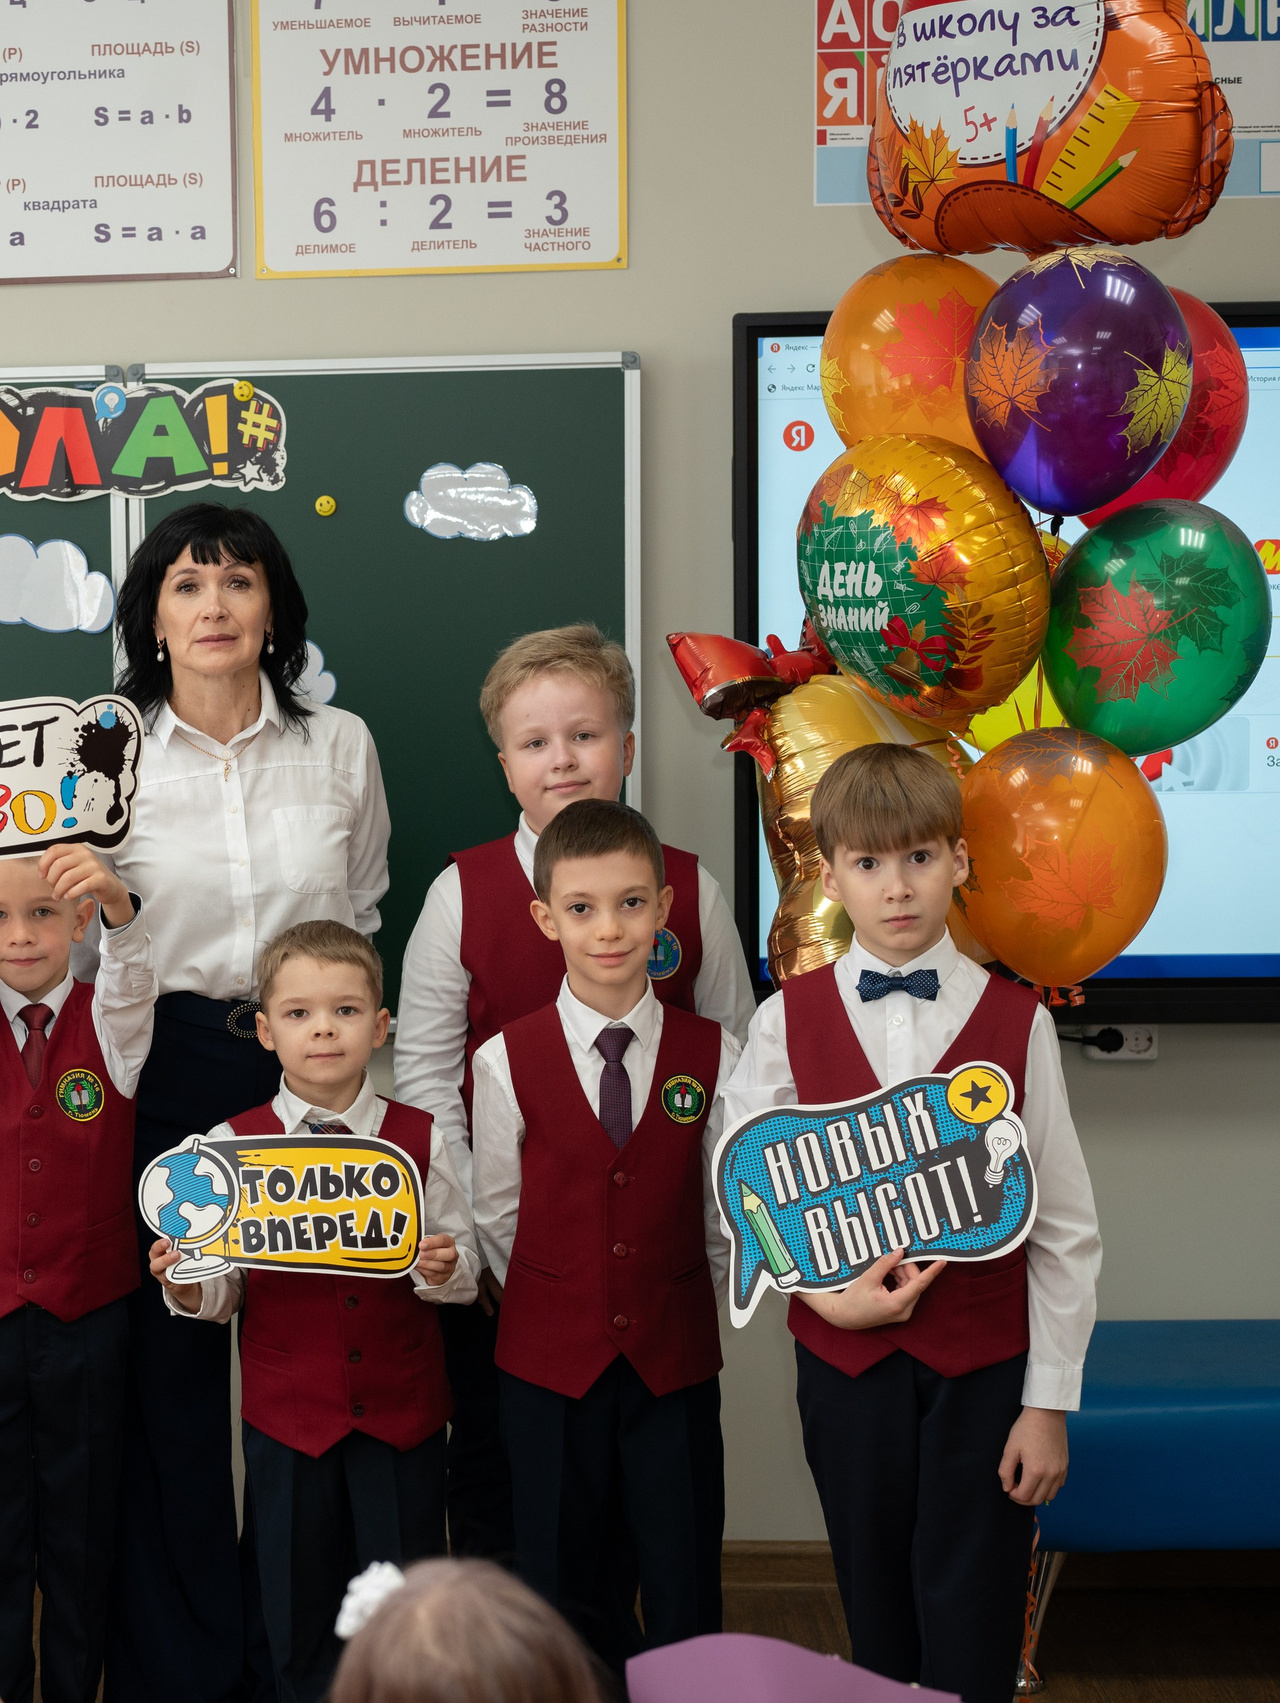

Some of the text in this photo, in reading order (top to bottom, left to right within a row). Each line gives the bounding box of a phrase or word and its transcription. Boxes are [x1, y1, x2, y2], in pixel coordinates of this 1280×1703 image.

[393, 13, 483, 27] ВЫЧИТАЕМОЕ
[521, 7, 589, 21] ЗНАЧЕНИЕ
[271, 17, 372, 32] УМЕНЬШАЕМОЕ
[521, 21, 589, 34] РАЗНОСТИ
[913, 8, 1020, 46] школу
[1033, 4, 1080, 28] за
[90, 39, 201, 58] ПЛОЩАДЬ (S)
[318, 40, 559, 77] УМНОЖЕНИЕ
[892, 47, 1080, 97] пятёрками
[309, 77, 569, 123] 4 2 8
[402, 126, 483, 139] МНОЖИТЕЛЬ
[522, 119, 590, 133] ЗНАЧЕНИЕ
[963, 105, 998, 143] 5+
[283, 130, 364, 143] МНОЖИТЕЛЬ
[505, 133, 608, 147] ПРОИЗВЕДЕНИЯ
[93, 171, 204, 189] ПЛОЩАДЬ (S)
[352, 153, 528, 193] ДЕЛЕНИЕ
[23, 198, 99, 214] квадрата
[312, 189, 569, 234] 6 2 3
[523, 226, 591, 239] ЗНАЧЕНИЕ
[294, 243, 357, 257] ДЕЛИМОЕ
[410, 239, 478, 253] ДЕЛИТЕЛЬ
[523, 240, 592, 253] ЧАСТНОГО
[816, 560, 884, 600] ДЕНЬ
[818, 601, 890, 631] ЗНАНИЙ
[763, 1091, 939, 1205] НОВЫХ
[239, 1162, 402, 1206] ТОЛЬКО
[804, 1156, 982, 1276] ВЫСОТ!
[239, 1207, 410, 1255] ВПЕРЕД!
